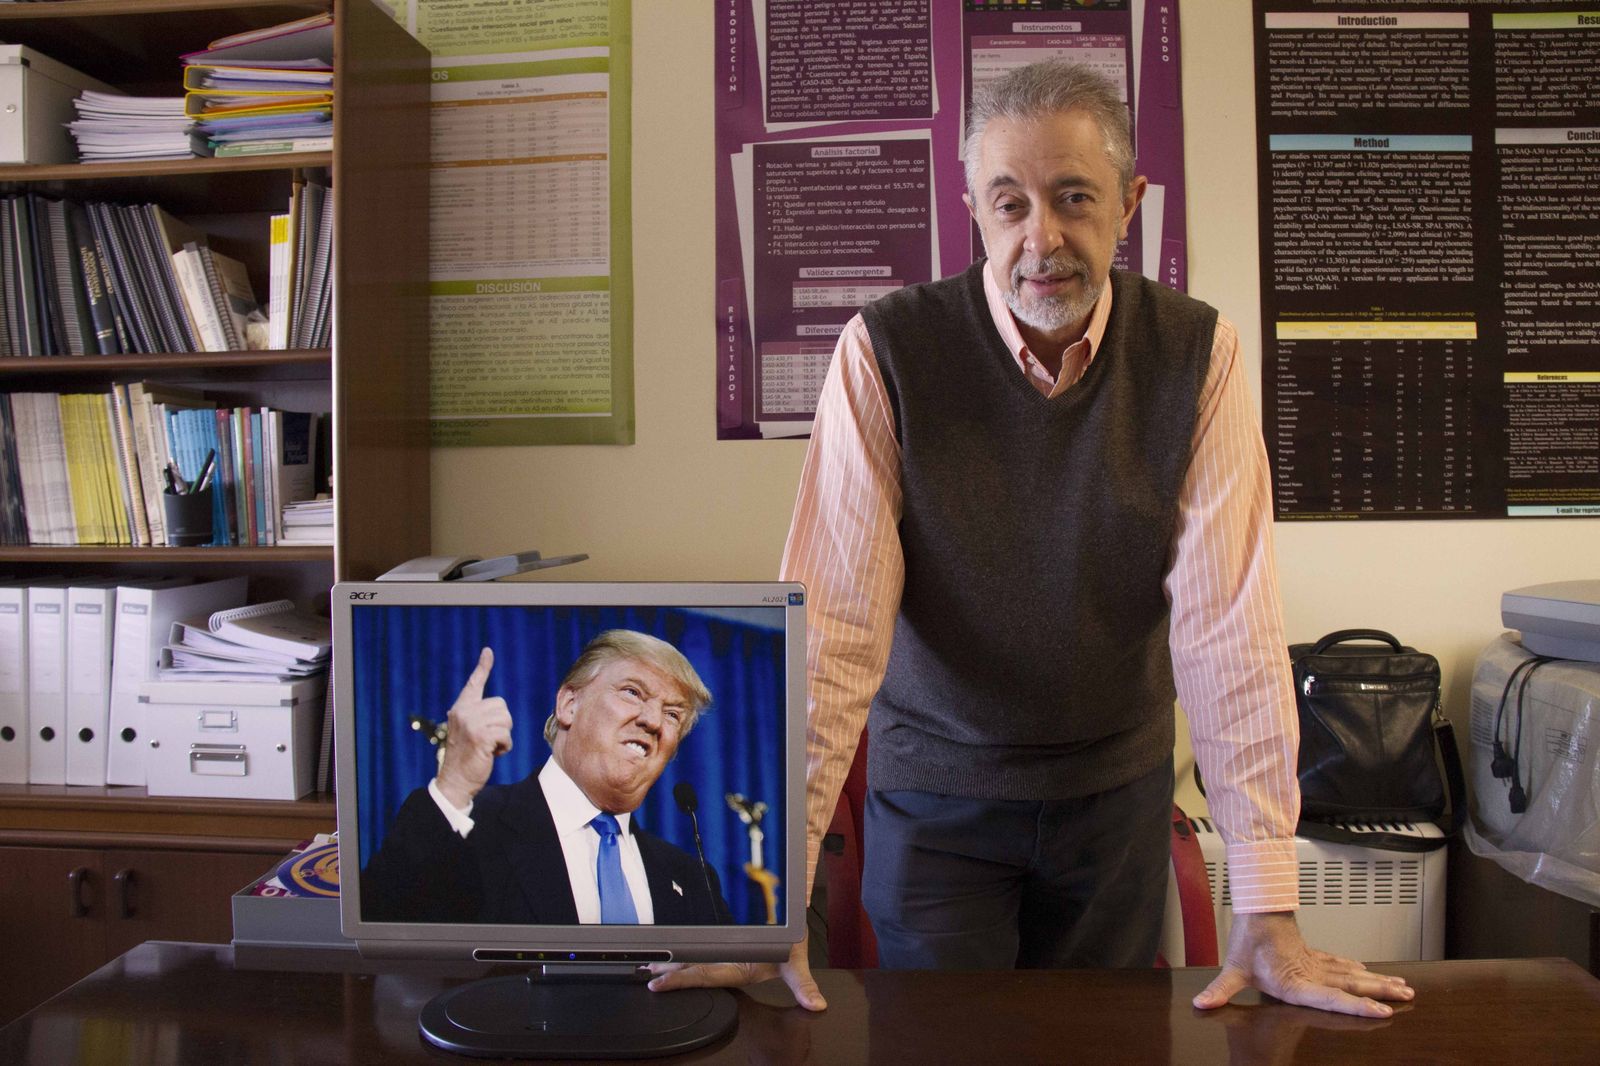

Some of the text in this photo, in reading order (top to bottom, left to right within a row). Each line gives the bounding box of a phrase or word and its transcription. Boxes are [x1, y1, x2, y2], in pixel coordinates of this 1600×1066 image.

[1338, 16, 1397, 26] Introduction
[1022, 22, 1072, 31] Instrumentos
[1354, 138, 1389, 148] Method
[836, 269, 884, 277] convergente
[1169, 257, 1177, 290] CON
[728, 306, 736, 400] RESULTADOS
[350, 592, 378, 600] acer
